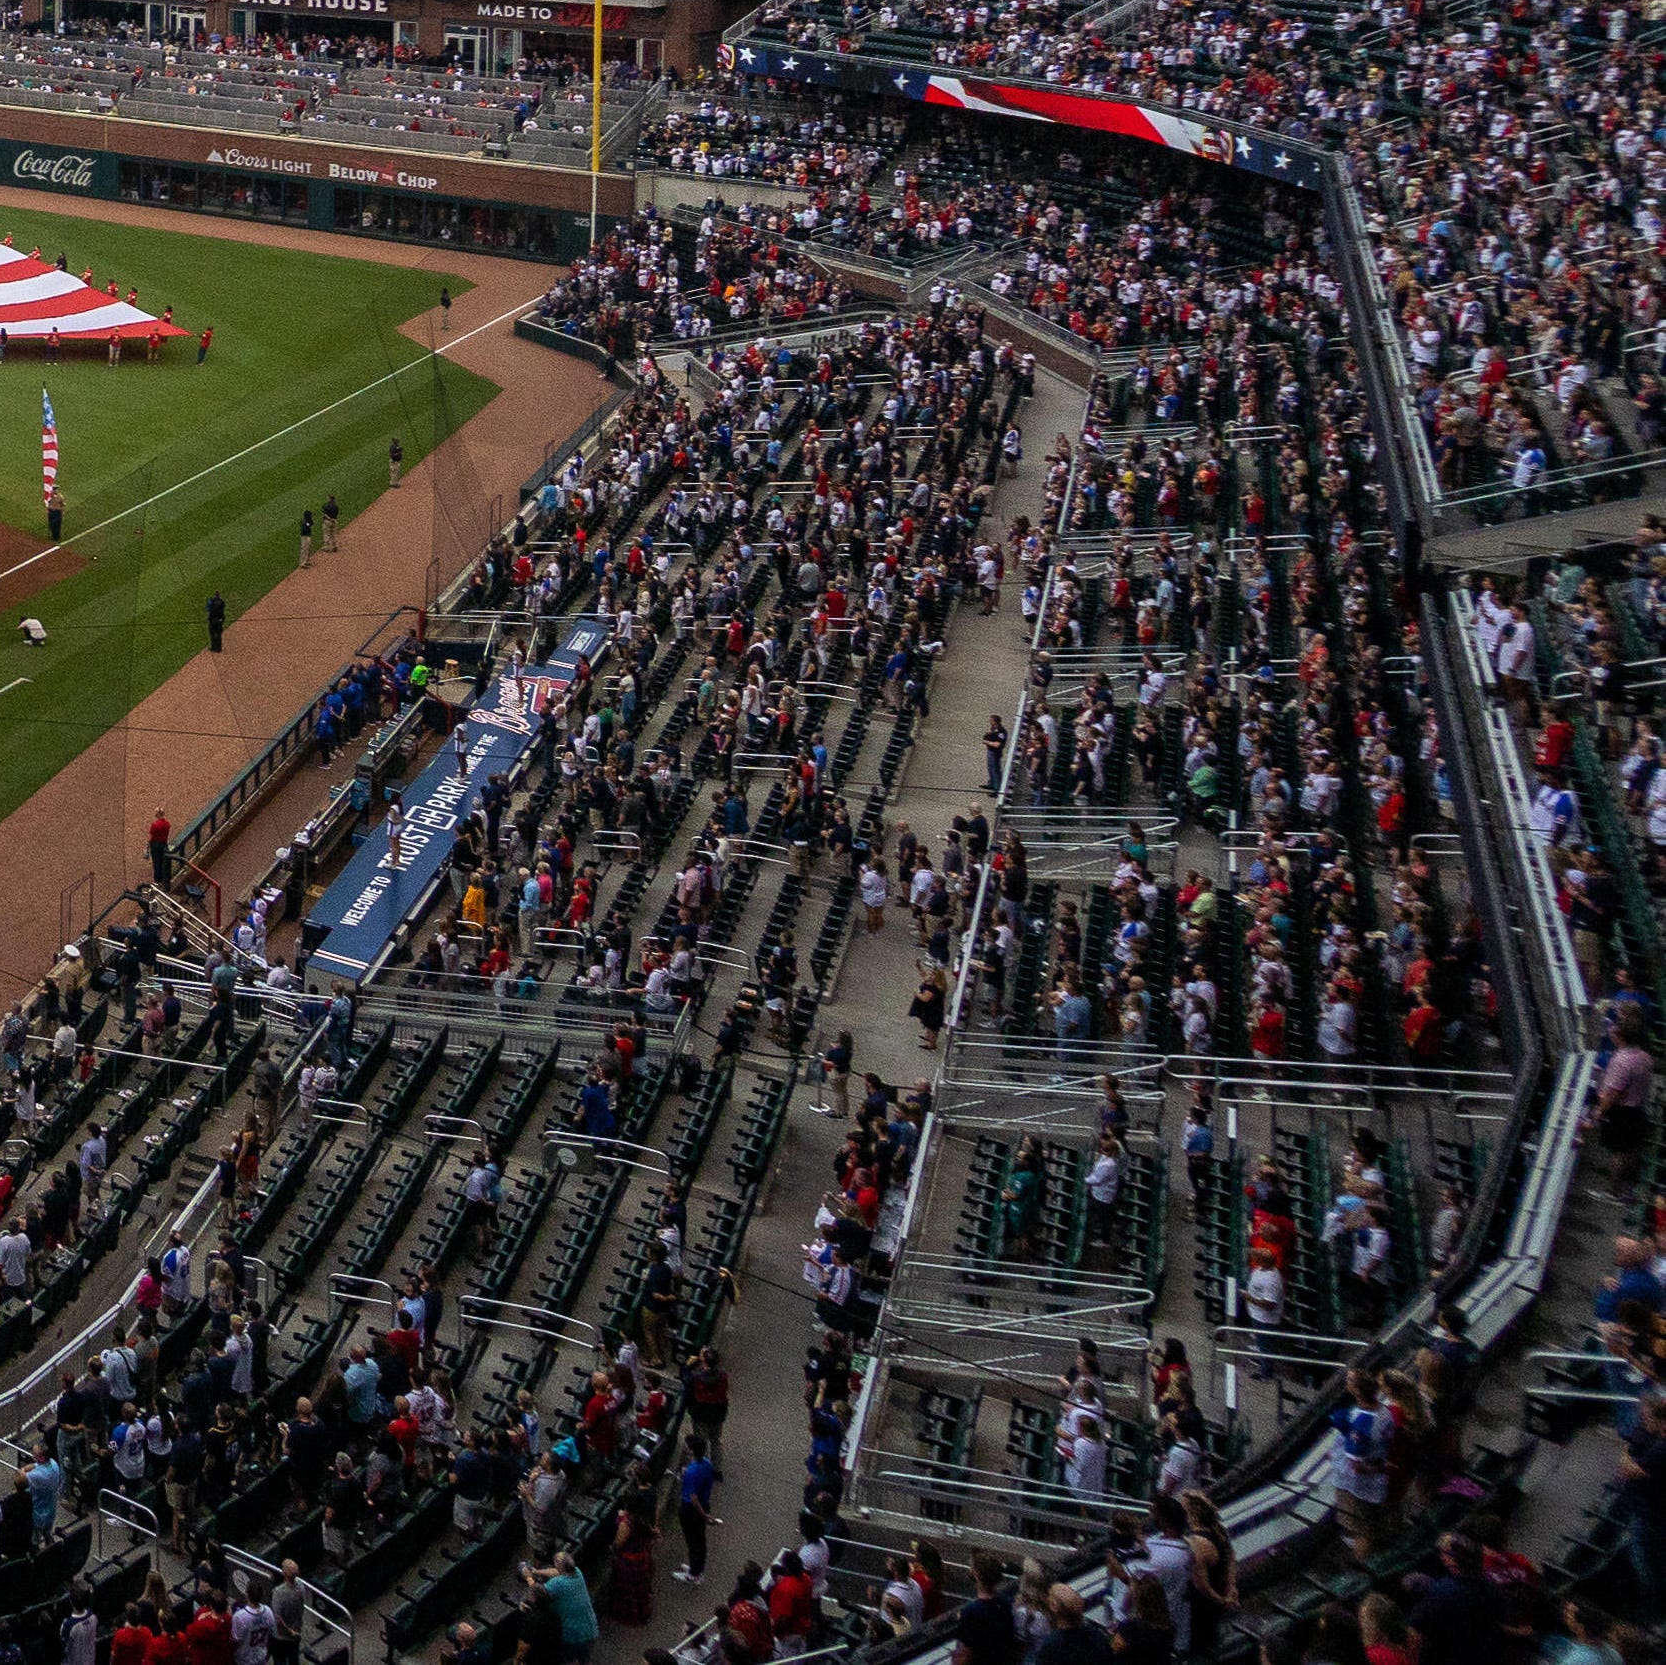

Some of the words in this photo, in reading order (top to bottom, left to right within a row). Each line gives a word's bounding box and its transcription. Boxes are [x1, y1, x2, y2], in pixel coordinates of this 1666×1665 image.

[477, 4, 526, 19] MADE
[529, 7, 553, 20] TO
[13, 149, 97, 188] Coca-Cola
[224, 147, 269, 169] Coors
[271, 159, 313, 175] LIGHT
[328, 163, 379, 184] BELOW
[397, 172, 438, 190] CHOP
[426, 776, 472, 811] PARK
[339, 886, 384, 927] WELCOME
[371, 875, 391, 888] TO
